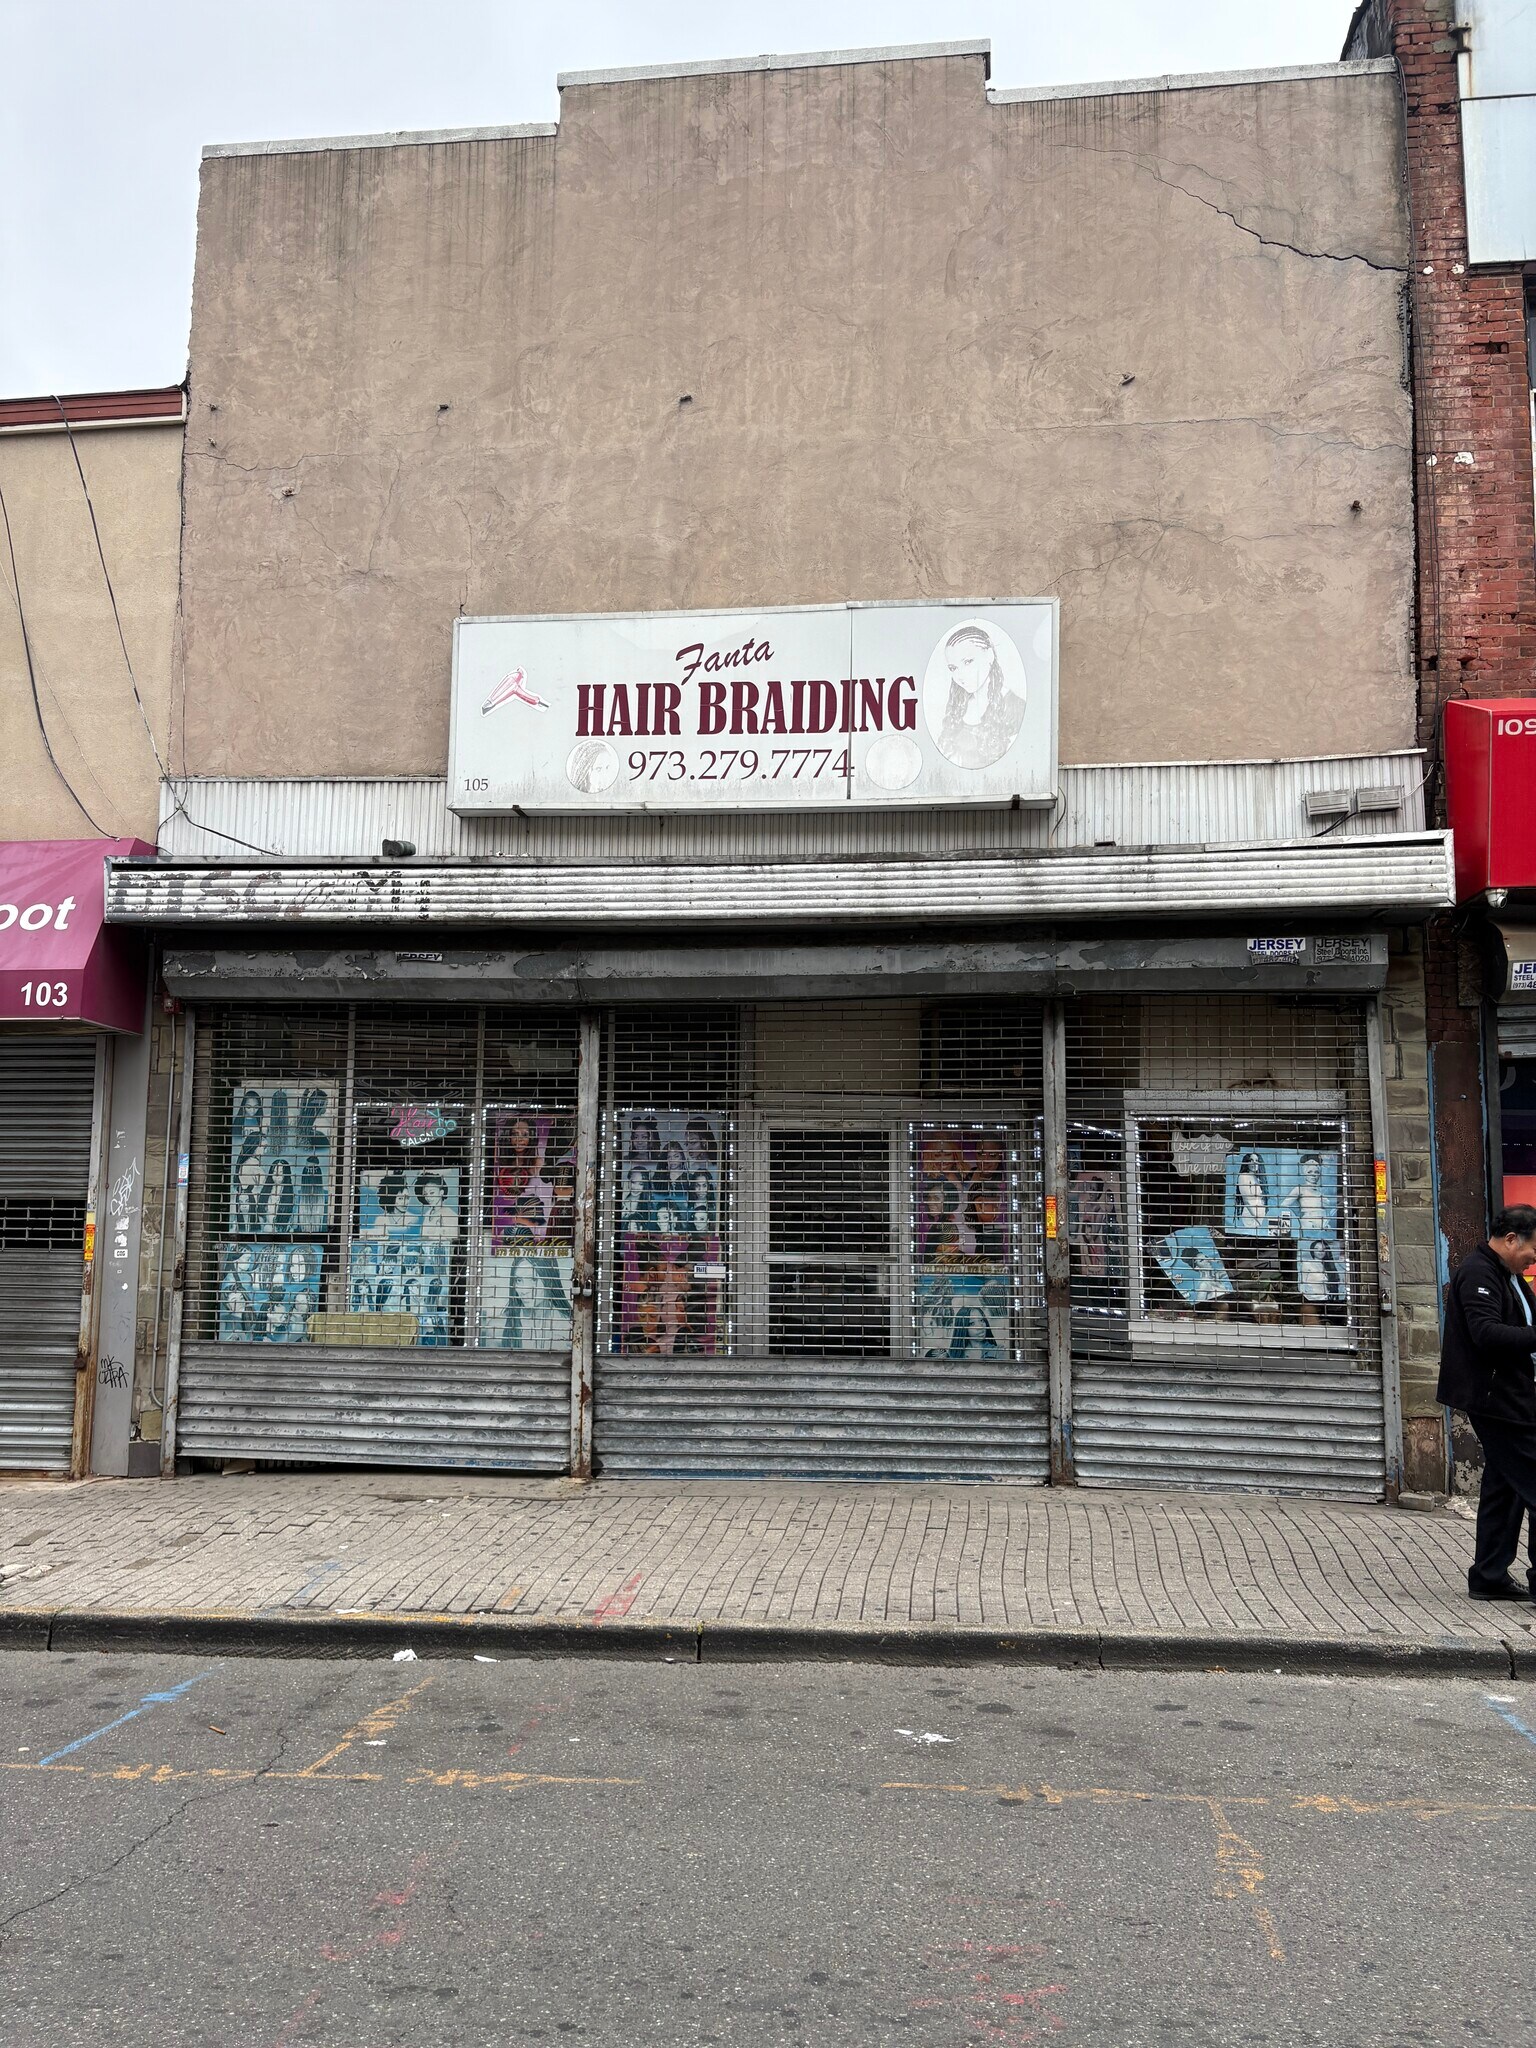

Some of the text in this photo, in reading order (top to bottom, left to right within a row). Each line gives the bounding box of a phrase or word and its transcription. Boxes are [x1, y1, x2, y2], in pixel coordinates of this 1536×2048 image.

[675, 636, 776, 685] Fanta
[575, 675, 918, 737] HAIR BRAIDING
[628, 747, 855, 783] 973.279.7774
[463, 777, 490, 793] 105
[1248, 938, 1305, 951] JERSEY
[1316, 937, 1369, 948] JERSEY
[20, 981, 69, 1007] 103
[401, 1130, 434, 1147] SALON
